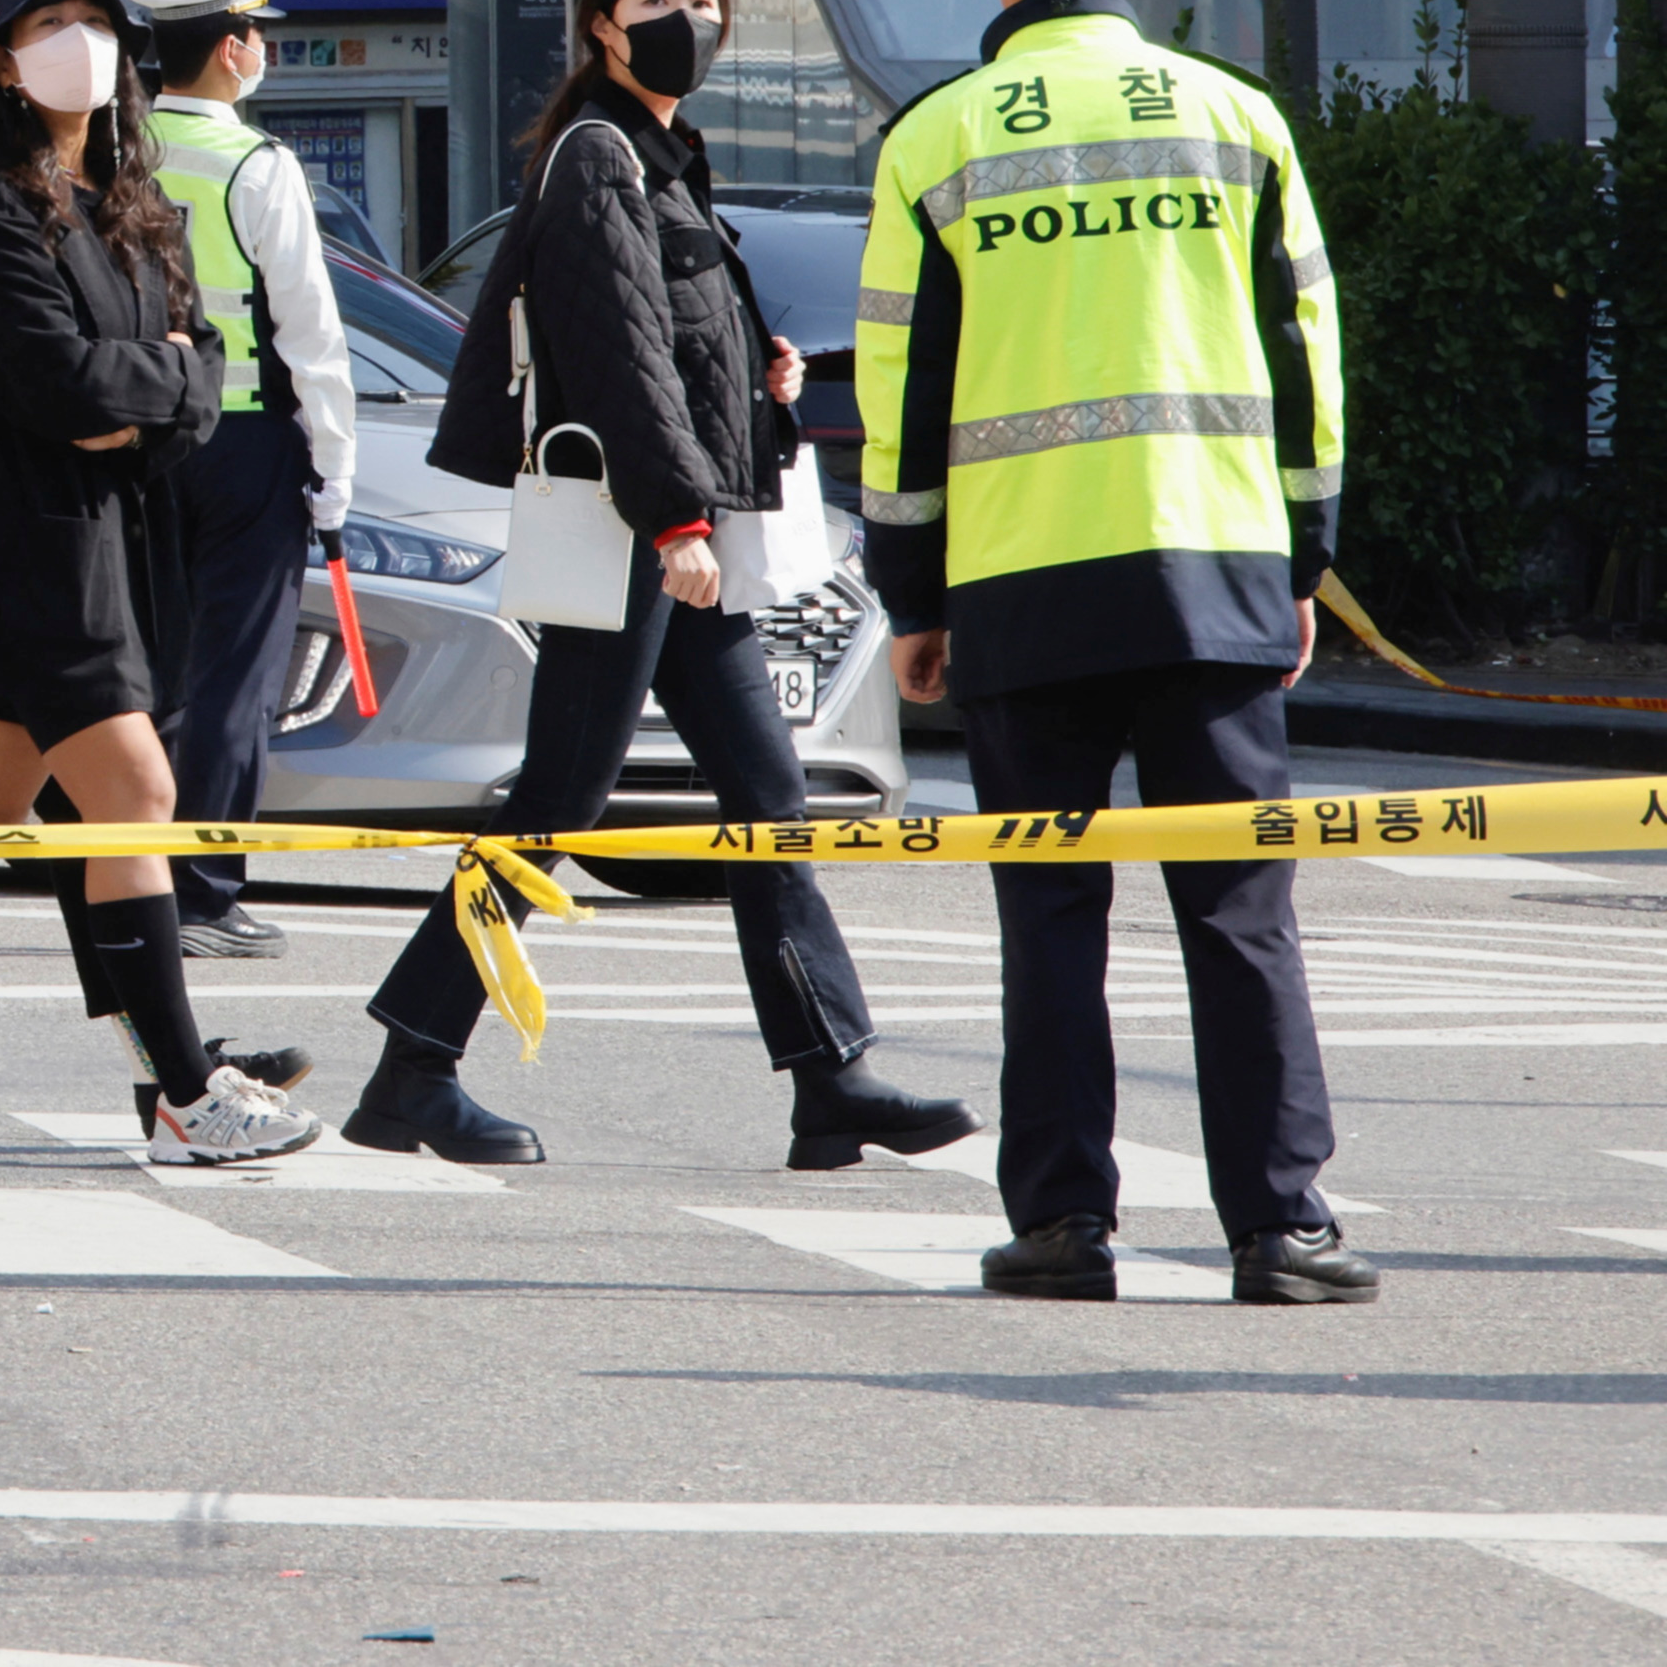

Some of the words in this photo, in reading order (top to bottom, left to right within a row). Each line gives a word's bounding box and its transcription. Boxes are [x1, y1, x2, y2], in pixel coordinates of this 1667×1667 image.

[993, 67, 1179, 134] 경찰
[972, 192, 1221, 254] POLICE
[710, 813, 944, 854] 서울소방
[987, 809, 1097, 849] 119
[1249, 793, 1489, 846] 출입통제
